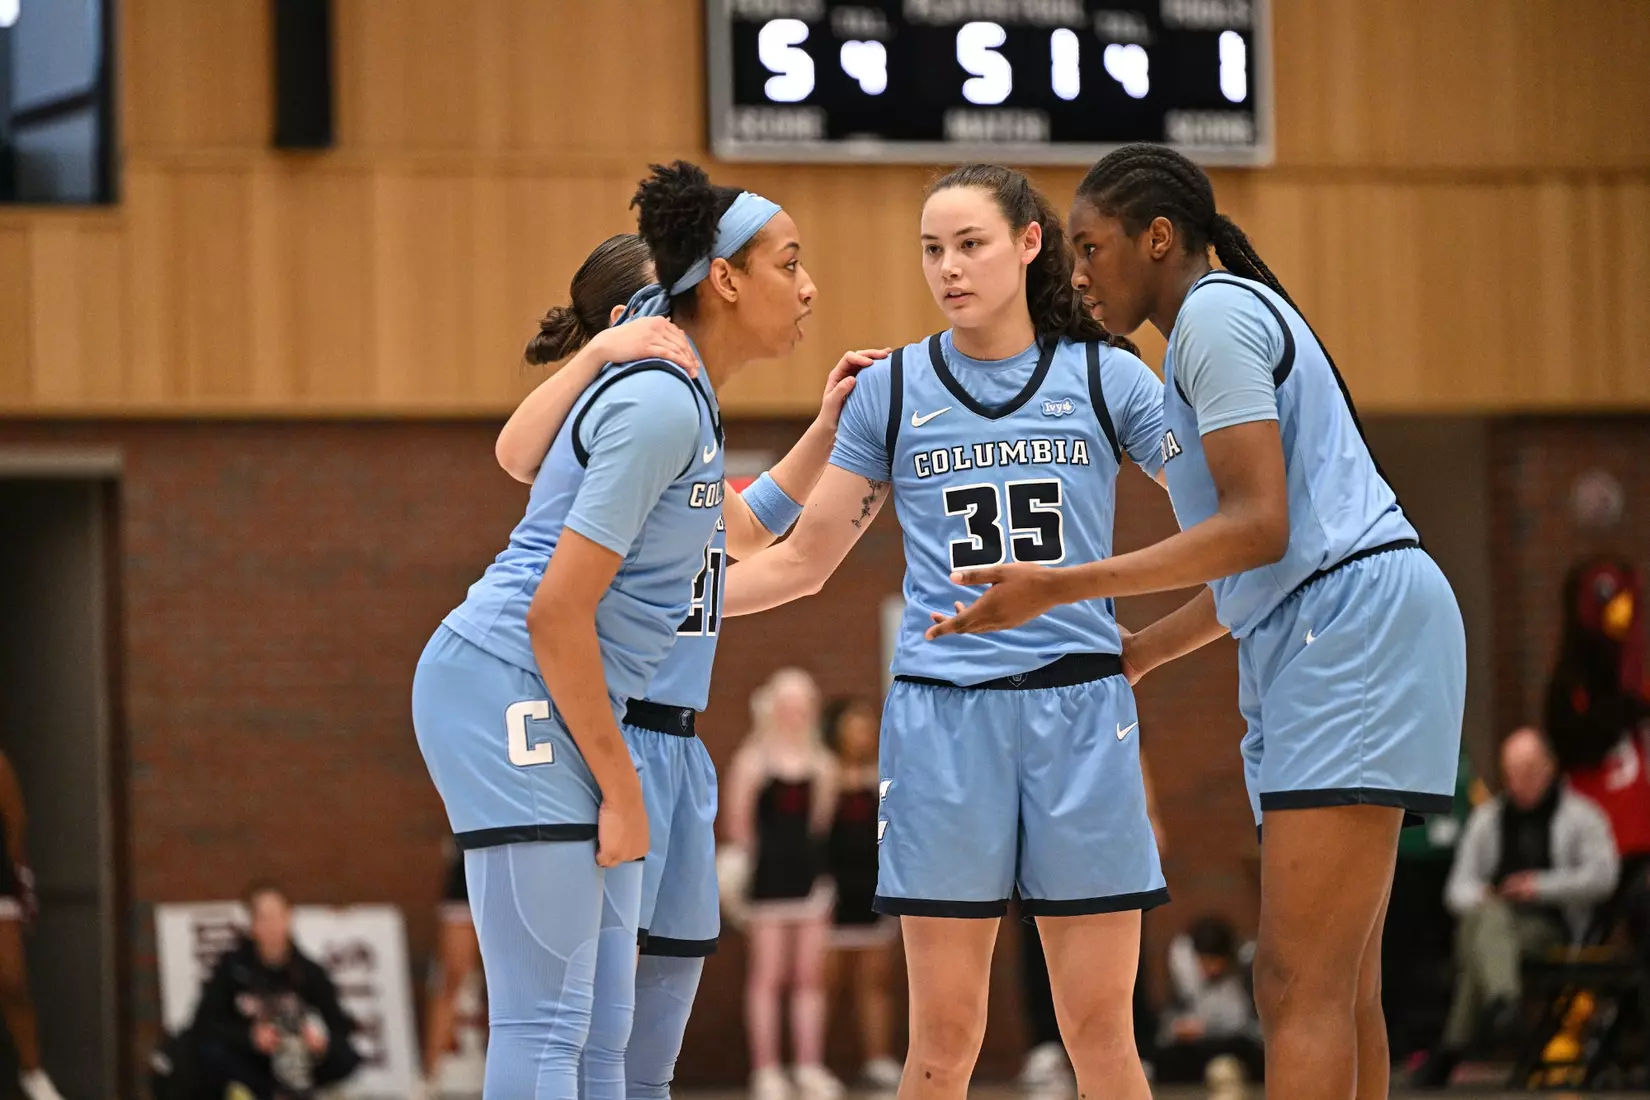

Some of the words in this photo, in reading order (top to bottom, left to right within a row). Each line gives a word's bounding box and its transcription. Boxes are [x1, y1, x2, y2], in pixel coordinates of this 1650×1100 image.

[914, 439, 1089, 479] COLUMBIA
[942, 478, 1066, 571] 35
[504, 699, 555, 767] C
